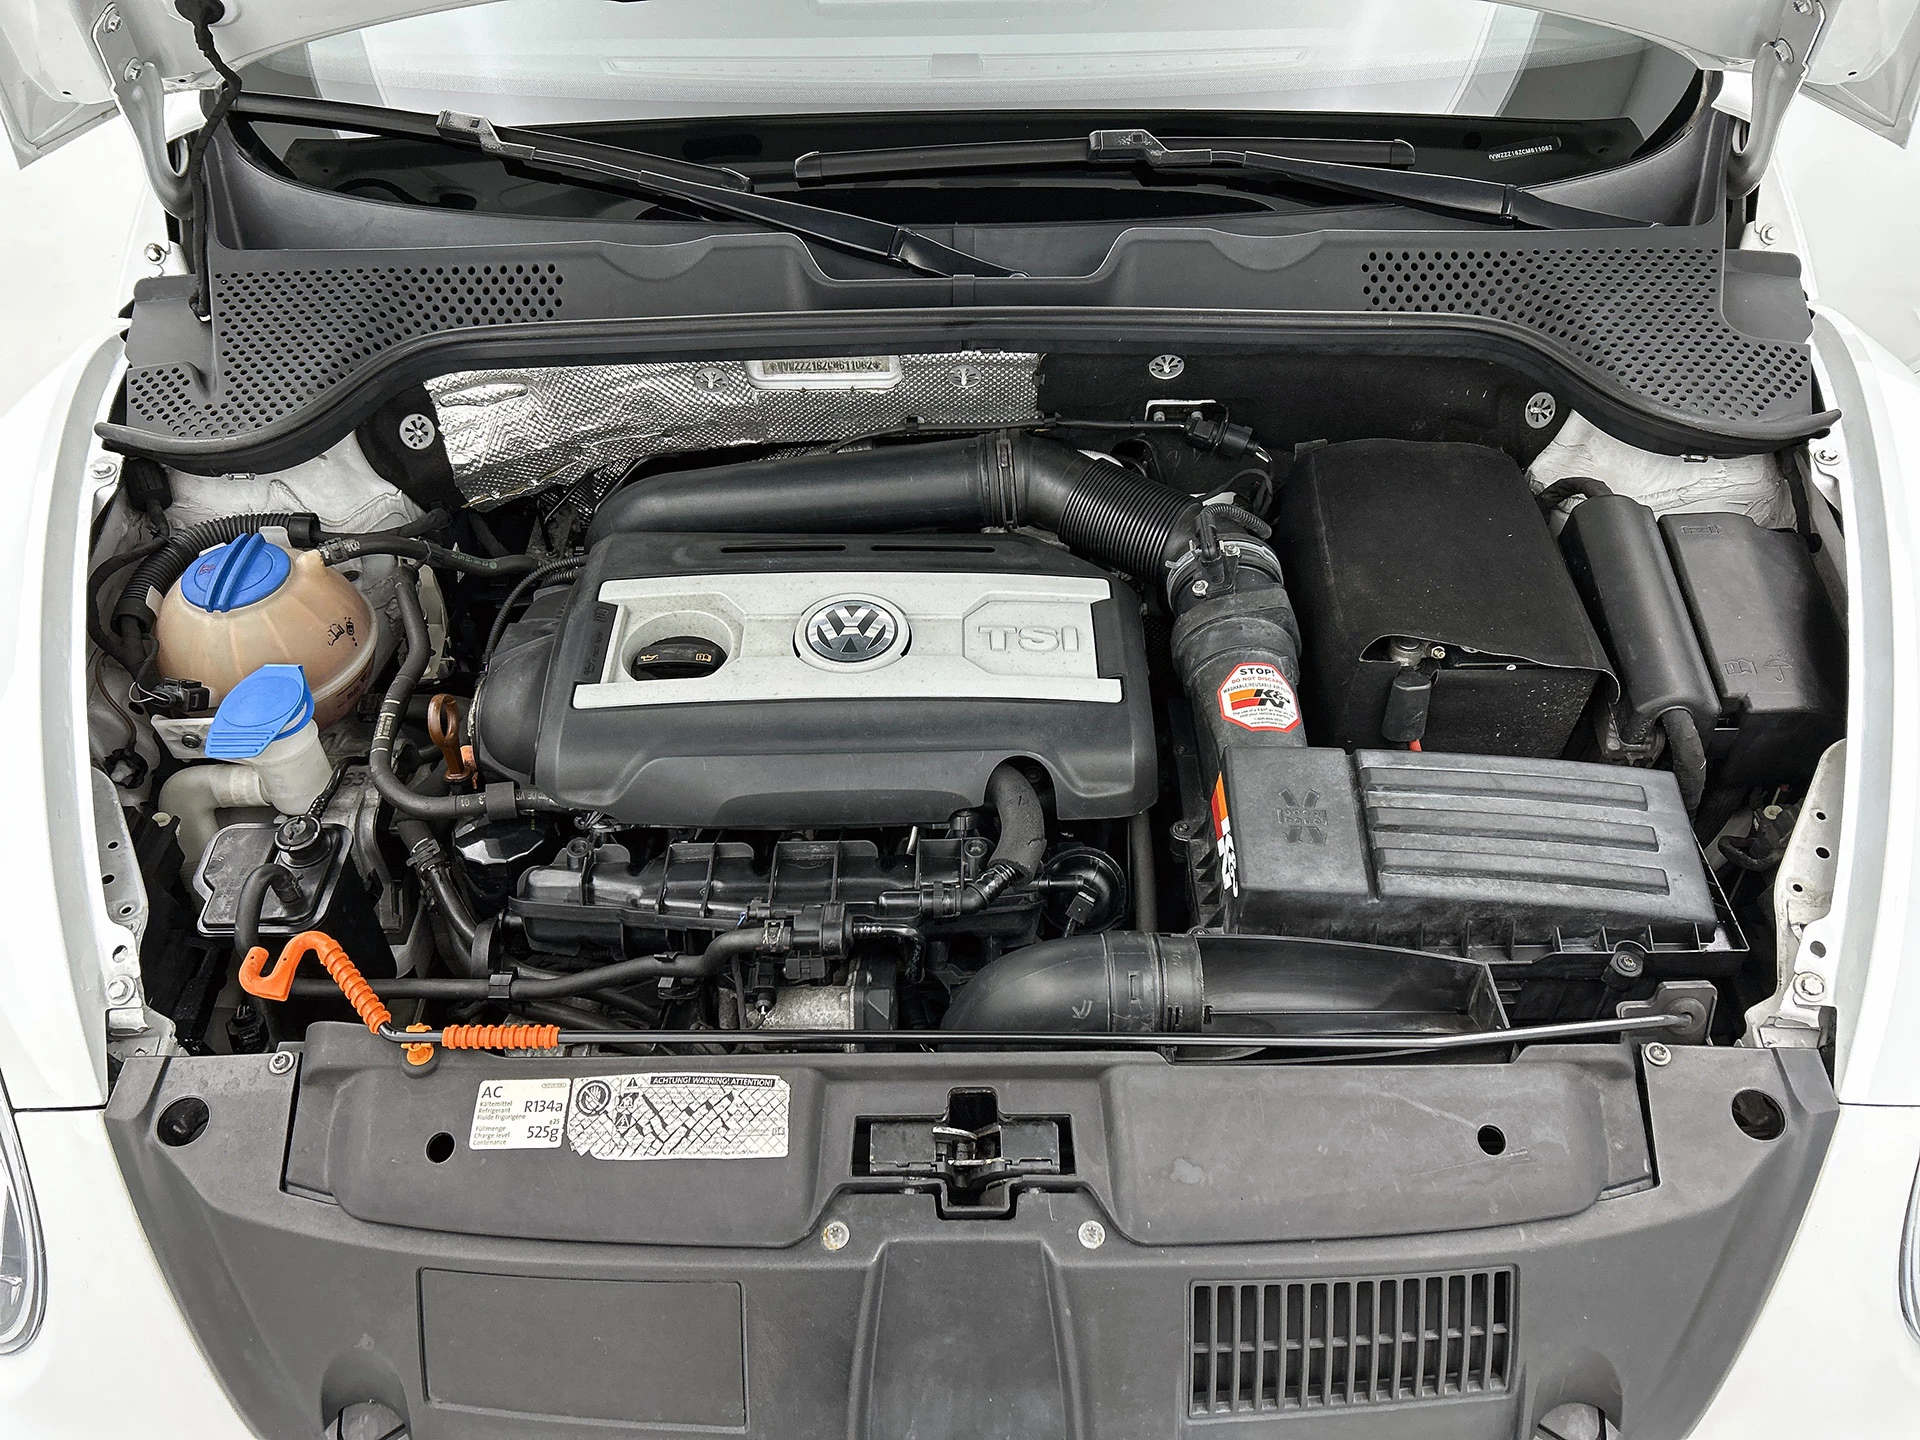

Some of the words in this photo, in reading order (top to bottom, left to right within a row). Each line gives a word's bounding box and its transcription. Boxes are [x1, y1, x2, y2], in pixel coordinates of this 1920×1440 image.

[978, 625, 1079, 652] TSI
[1240, 668, 1275, 677] STOP!
[1257, 676, 1283, 685] DISCARD
[1253, 688, 1291, 709] K&N
[1217, 816, 1239, 898] K&N
[652, 1076, 691, 1085] ACHTUNG!
[693, 1077, 730, 1087] WARNING!
[731, 1079, 774, 1088] ATTENTION!
[481, 1086, 503, 1099] AC
[524, 1100, 563, 1113] R134a
[527, 1126, 559, 1142] 525g
